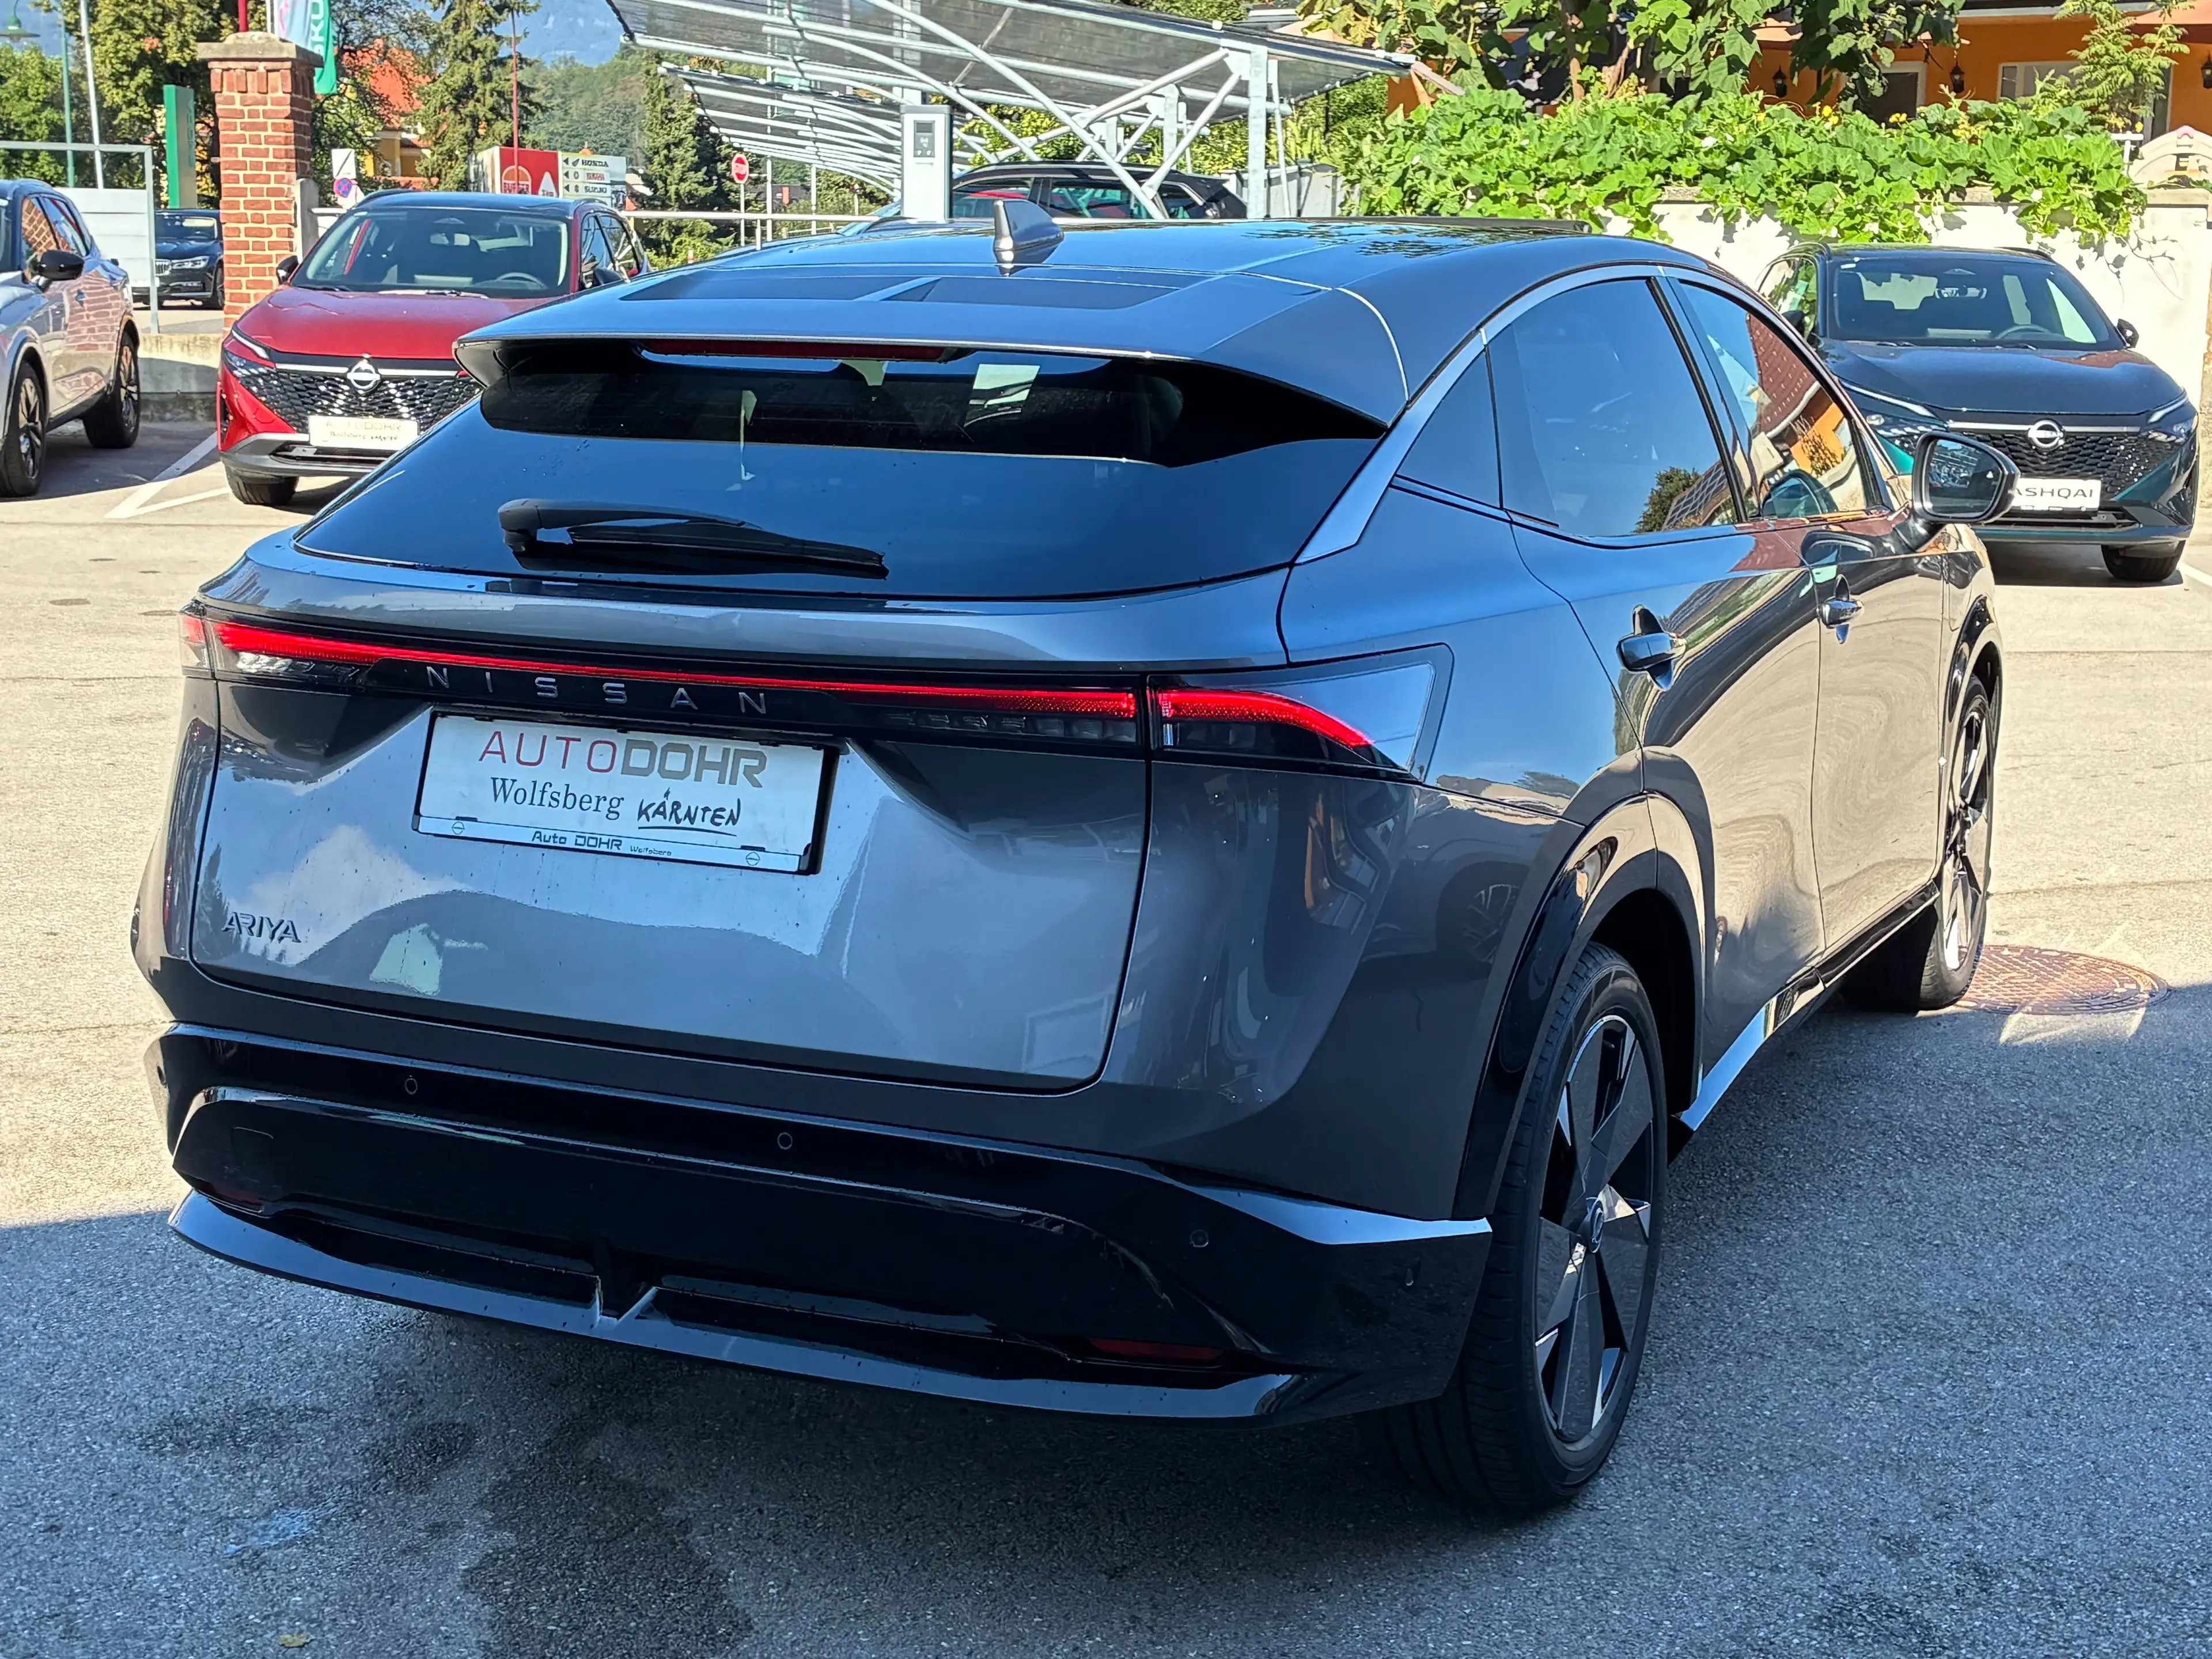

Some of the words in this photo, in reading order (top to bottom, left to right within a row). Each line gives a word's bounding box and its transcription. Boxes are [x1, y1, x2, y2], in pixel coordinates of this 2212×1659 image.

[582, 159, 609, 167] HONDA
[426, 665, 767, 714] NISSAN
[479, 731, 767, 788] AUTODOHR
[491, 777, 624, 820] Wolfsberg
[532, 831, 567, 844] Auto
[574, 835, 623, 851] DOHR
[221, 911, 302, 944] ARIYA
